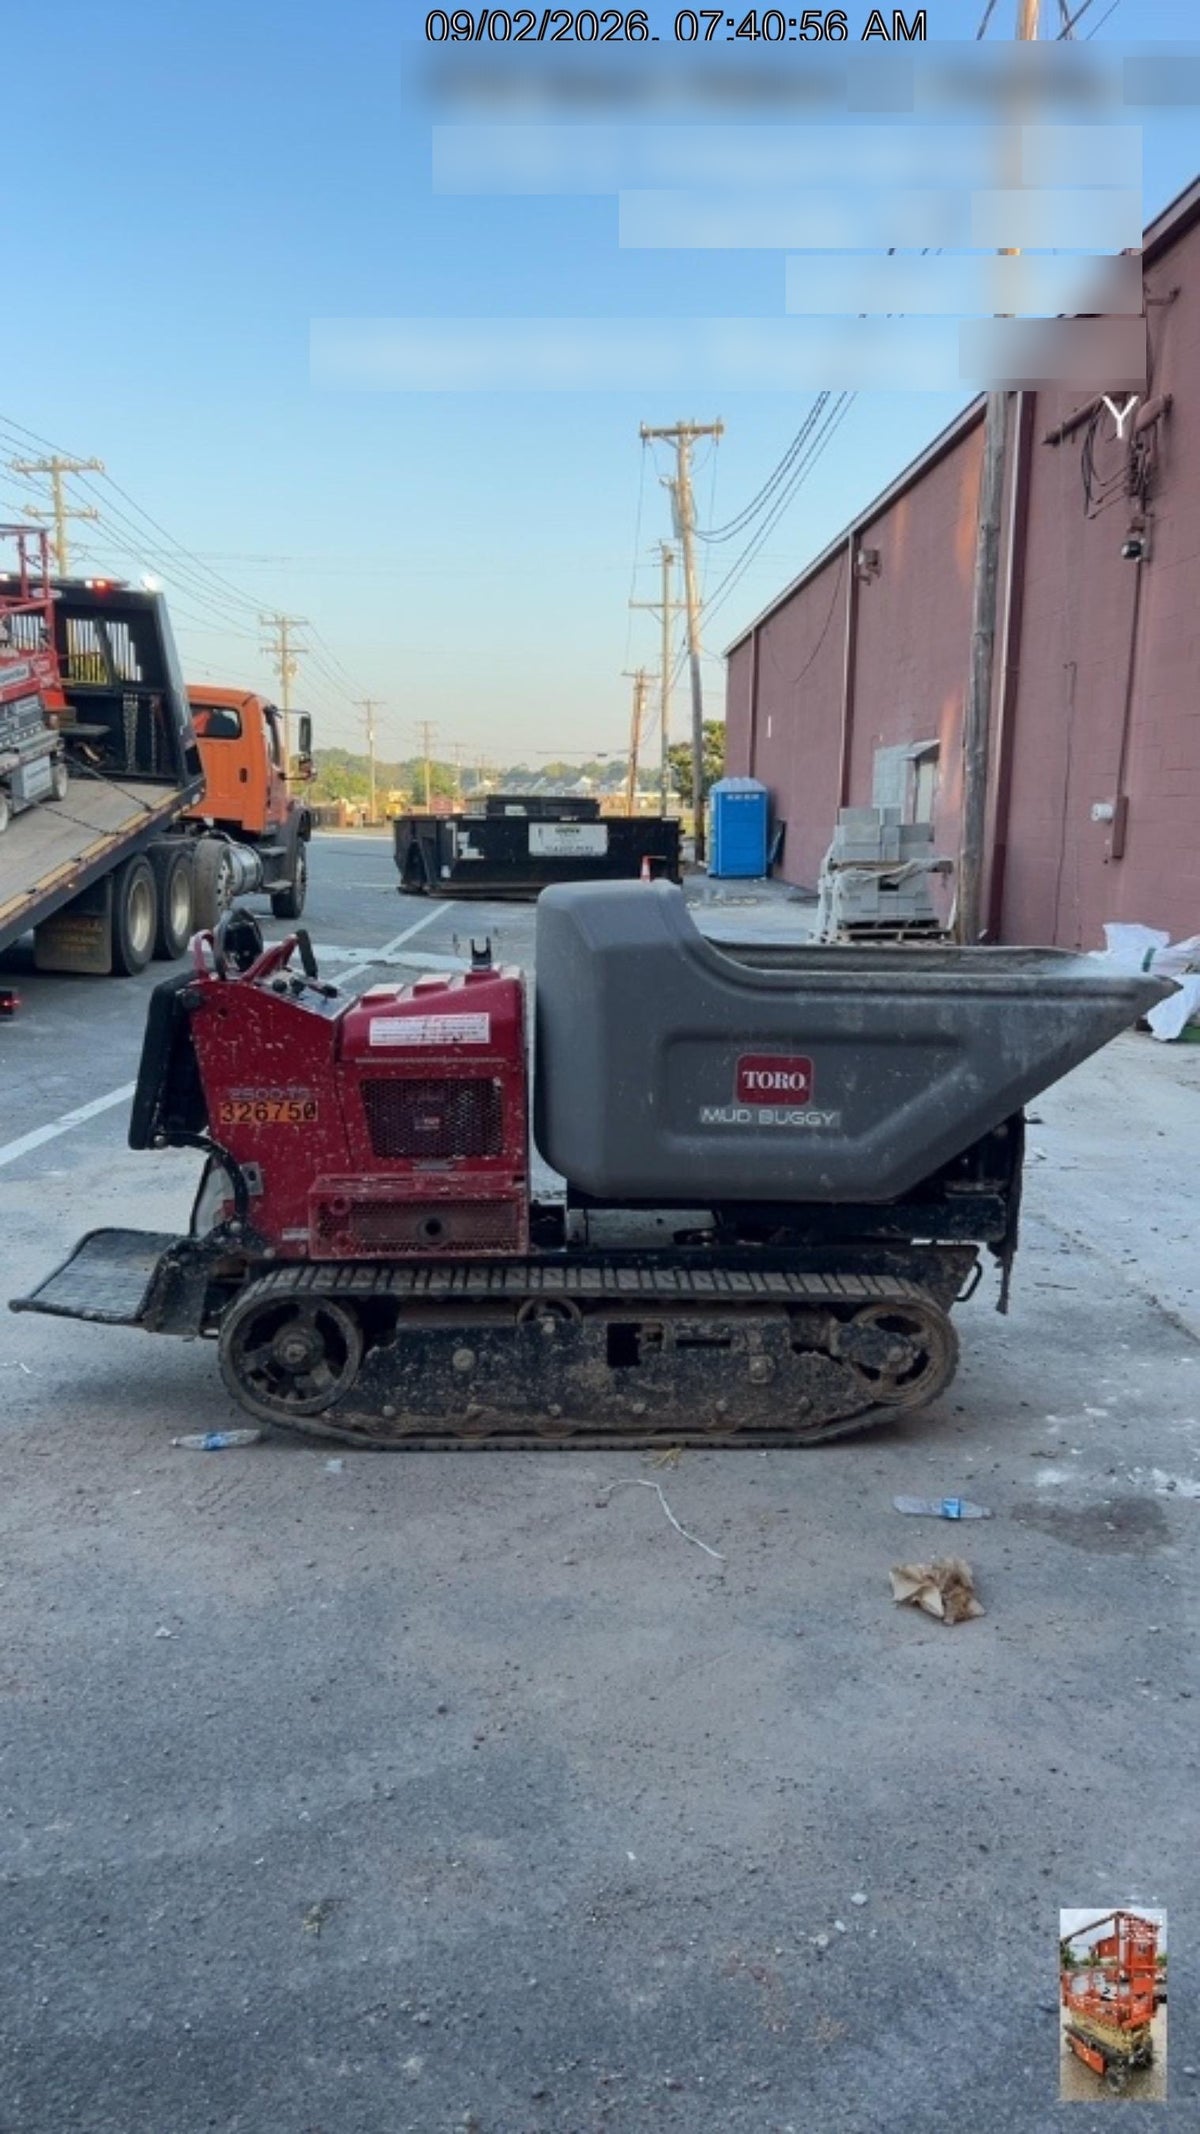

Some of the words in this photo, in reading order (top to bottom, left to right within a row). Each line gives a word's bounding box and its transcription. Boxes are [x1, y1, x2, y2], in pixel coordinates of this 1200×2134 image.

[742, 1071, 806, 1090] TORO
[221, 1102, 316, 1122] 326750
[701, 1108, 752, 1123] MUD
[758, 1109, 835, 1126] BUGGY
